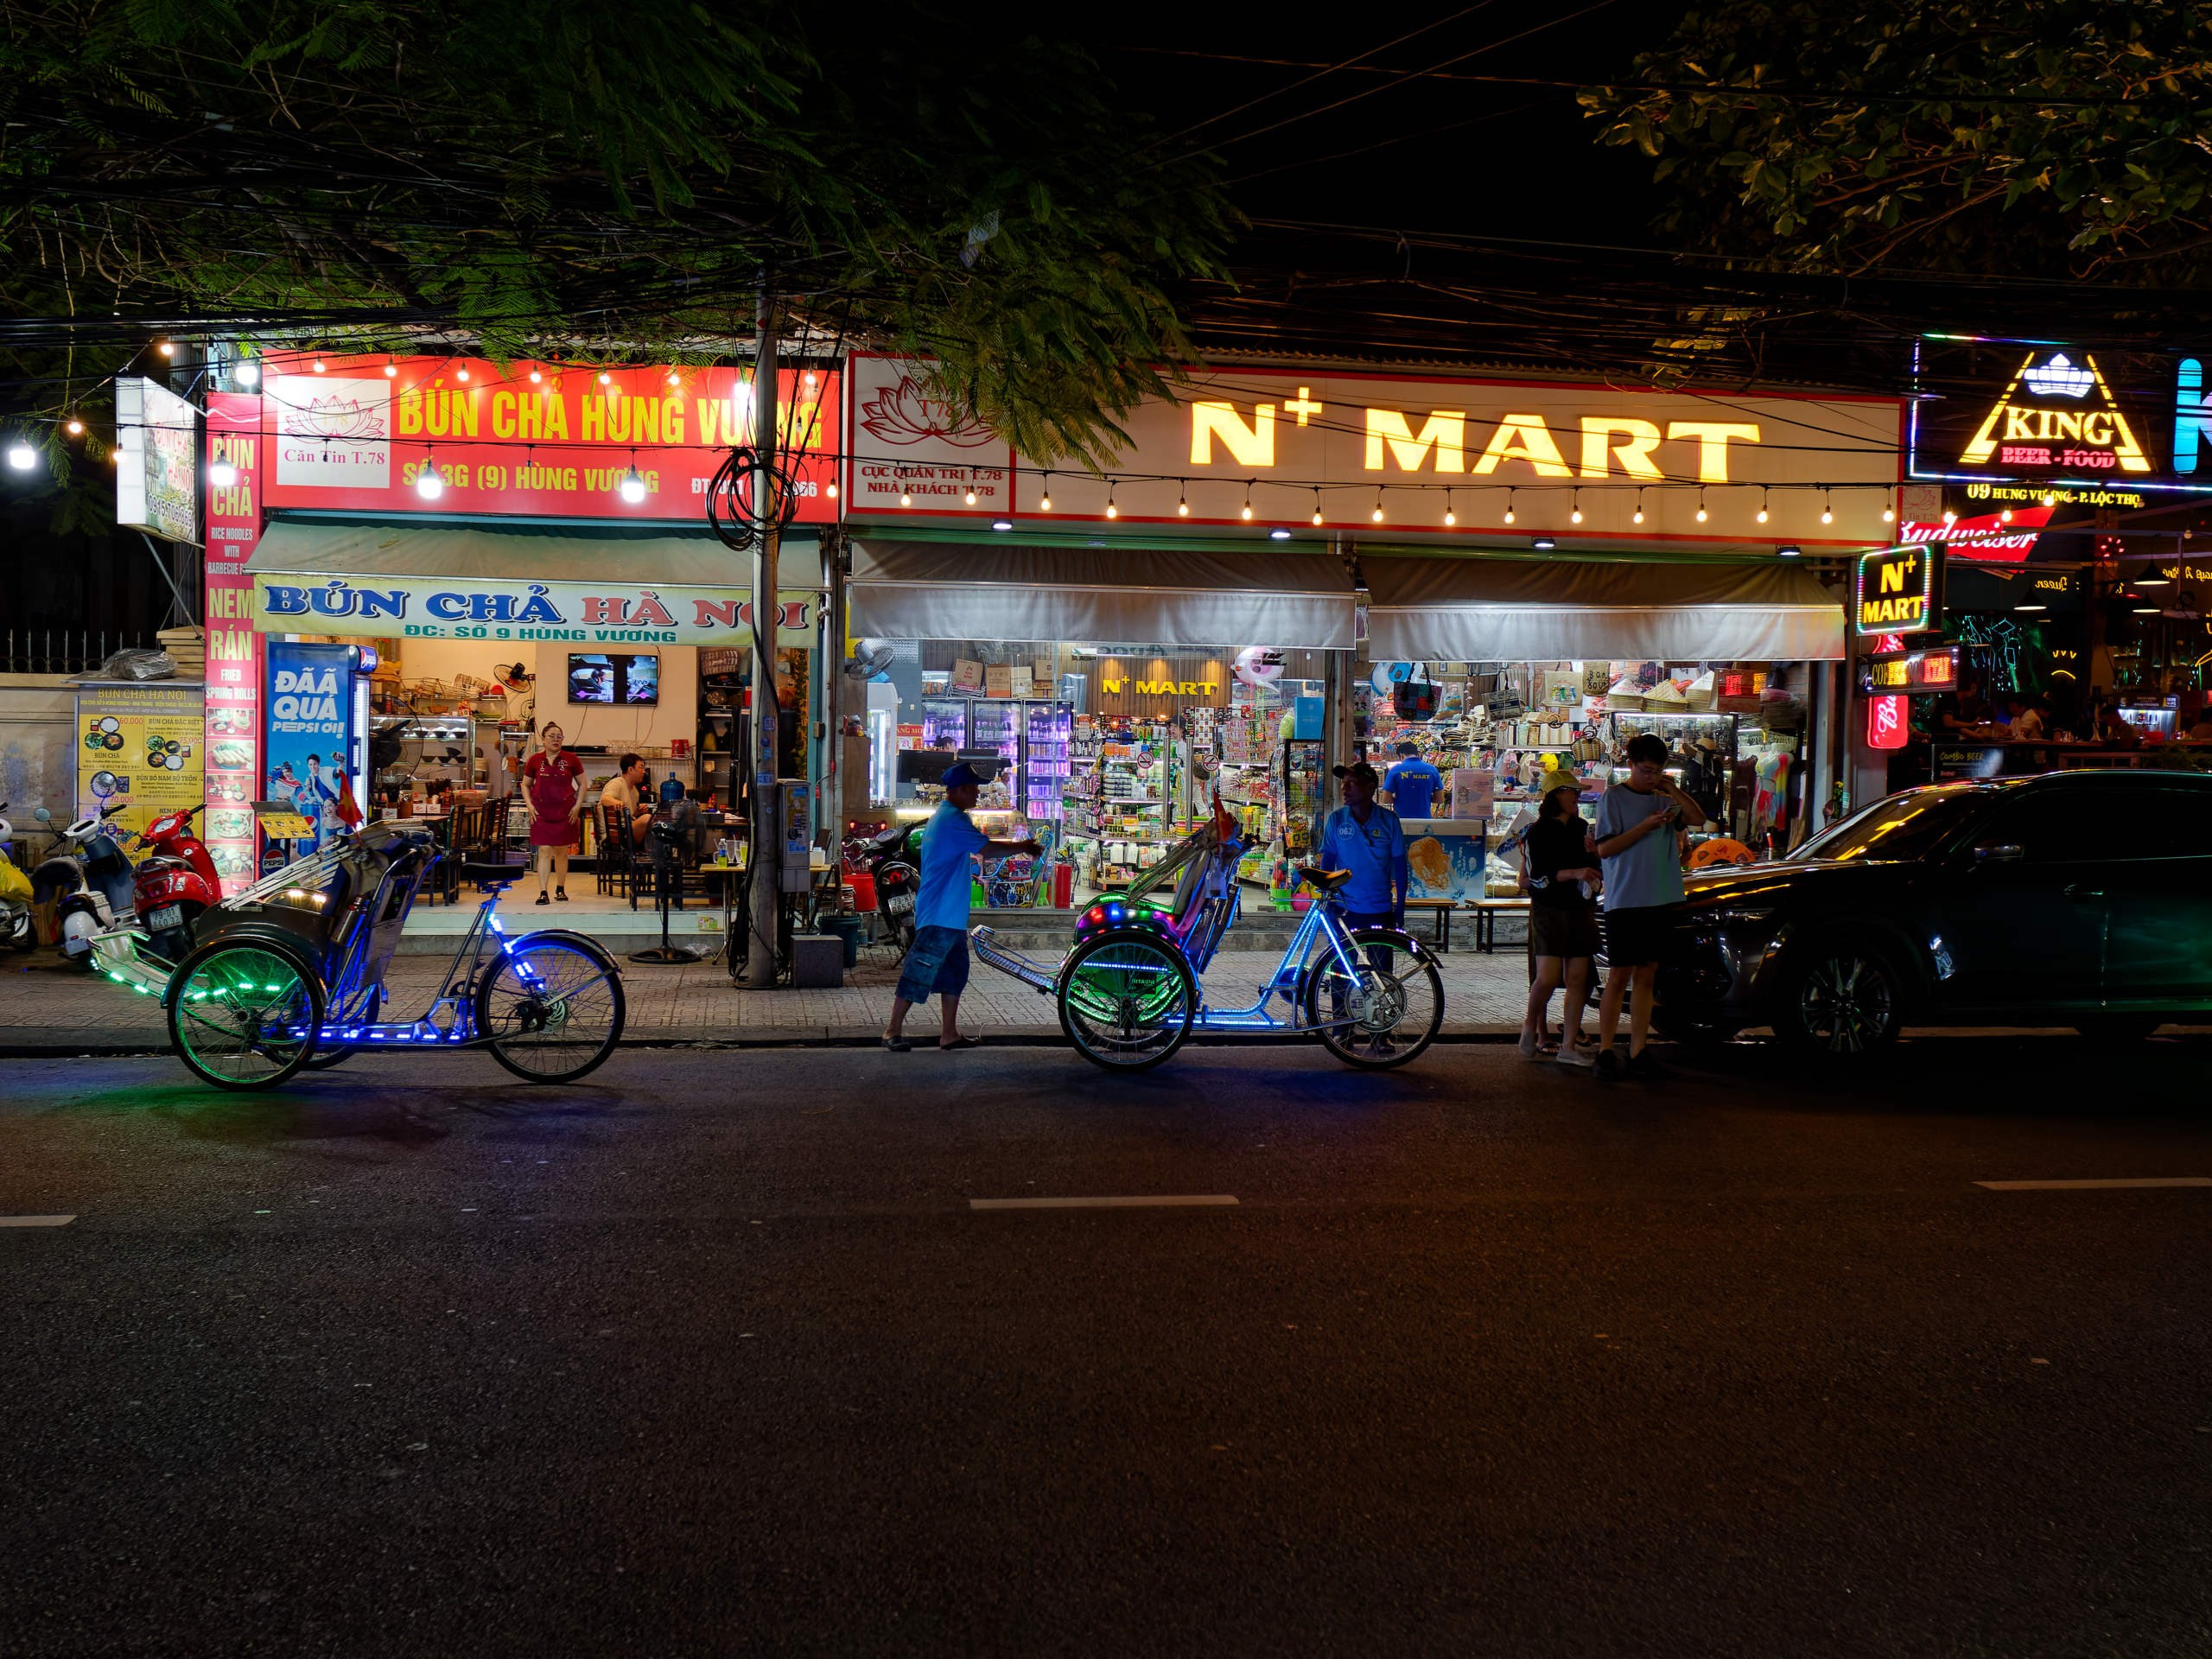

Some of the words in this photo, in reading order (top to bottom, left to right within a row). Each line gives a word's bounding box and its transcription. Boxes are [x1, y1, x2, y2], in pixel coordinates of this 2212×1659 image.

[399, 378, 478, 437] BÚN
[493, 378, 569, 441] CHẢ
[582, 385, 684, 444] HÙNG
[697, 397, 822, 448] VƯNG
[2003, 405, 2114, 445] KING
[212, 433, 255, 470] BÚN
[284, 448, 315, 464] Căn
[352, 451, 385, 465] T.78
[1364, 409, 1761, 484] MART
[2000, 447, 2052, 466] BEER
[2063, 449, 2116, 468] FOOD
[441, 466, 469, 488] 3G
[477, 466, 507, 491] (9)
[516, 460, 576, 493] HÙNG
[584, 466, 659, 494] VƯƠG
[861, 466, 890, 480] CỤC
[893, 465, 935, 480] QUẢN
[939, 467, 965, 482] TRỊ
[970, 469, 1002, 481] T.78
[212, 476, 254, 518] CHẢ
[867, 480, 900, 493] NHÀ
[906, 481, 957, 496] KHÁCH
[962, 485, 995, 497] T78
[1967, 484, 1990, 499] 09
[2089, 492, 2114, 507] LỘC
[211, 527, 225, 540] RICE
[224, 545, 239, 557] WITH
[207, 562, 238, 575] BARBECUE
[208, 588, 254, 620] NEM
[264, 580, 411, 619] BÚN
[425, 584, 567, 623] CHẢ
[581, 590, 679, 626] HÀ
[1863, 595, 1925, 624] MART
[210, 624, 252, 661] RÁN
[404, 625, 446, 637] ĐC:
[454, 622, 487, 639] SỐ
[497, 627, 511, 639] 9
[519, 626, 587, 641] HÙNG
[595, 628, 677, 643] VƯƠNG
[221, 669, 242, 682] FRIED
[206, 687, 232, 700] SPRING
[234, 687, 257, 701] ROLLS
[1135, 680, 1218, 696] MART
[273, 692, 338, 723] QUÁ
[272, 721, 319, 734] PEPSI
